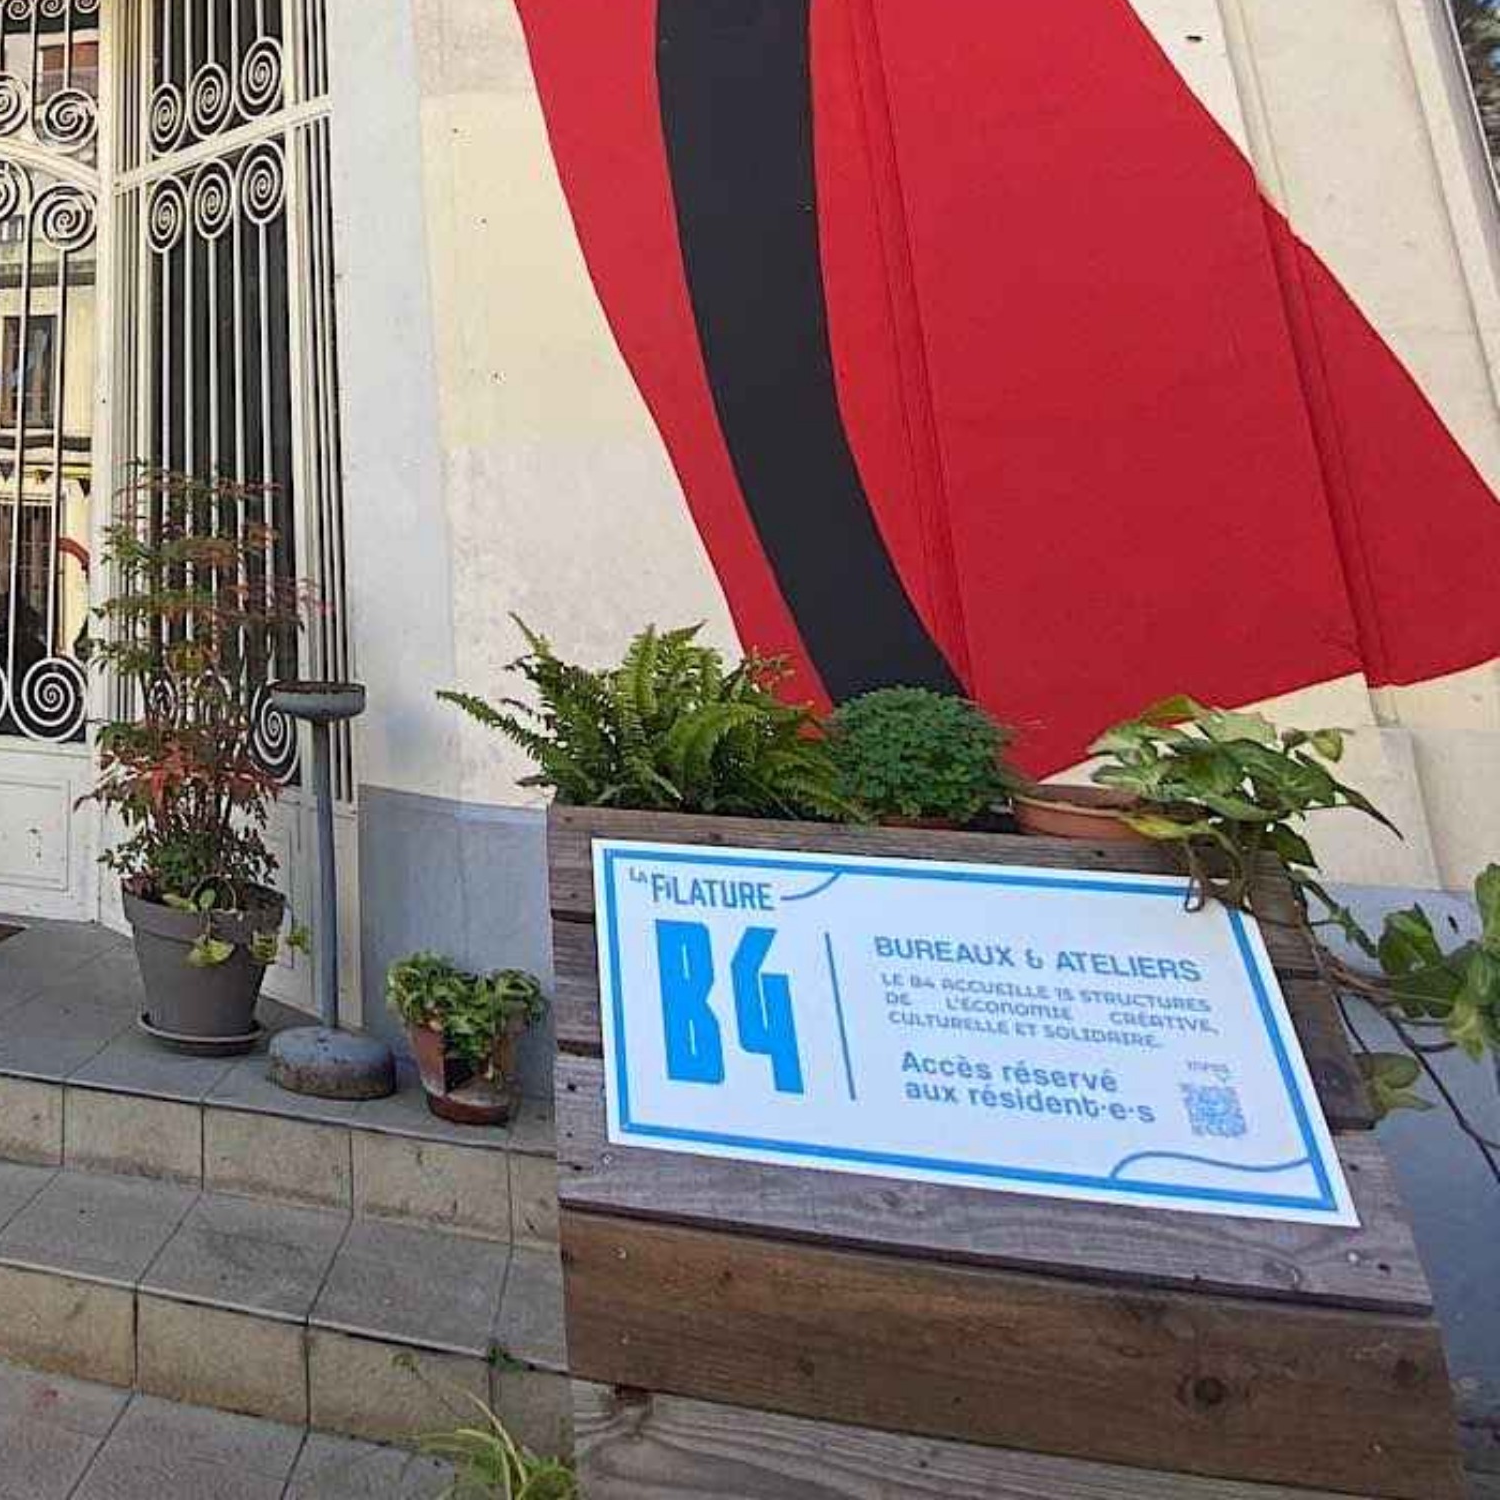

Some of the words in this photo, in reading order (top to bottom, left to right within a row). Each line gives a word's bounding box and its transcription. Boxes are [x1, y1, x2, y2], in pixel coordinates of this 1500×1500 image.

[629, 866, 648, 884] LA
[874, 935, 1015, 968] BUREAUX
[1056, 950, 1202, 983] ATELIERS
[655, 918, 804, 1095] B4
[881, 972, 905, 987] LE
[941, 977, 1051, 999] ACCUEILLE
[1078, 990, 1212, 1013] STRUCTURES
[886, 991, 912, 1006] DE
[888, 1010, 1010, 1036] CULTURELLE
[901, 1051, 992, 1081] Accès
[1002, 1060, 1118, 1093] réservé
[905, 1080, 959, 1104] aux
